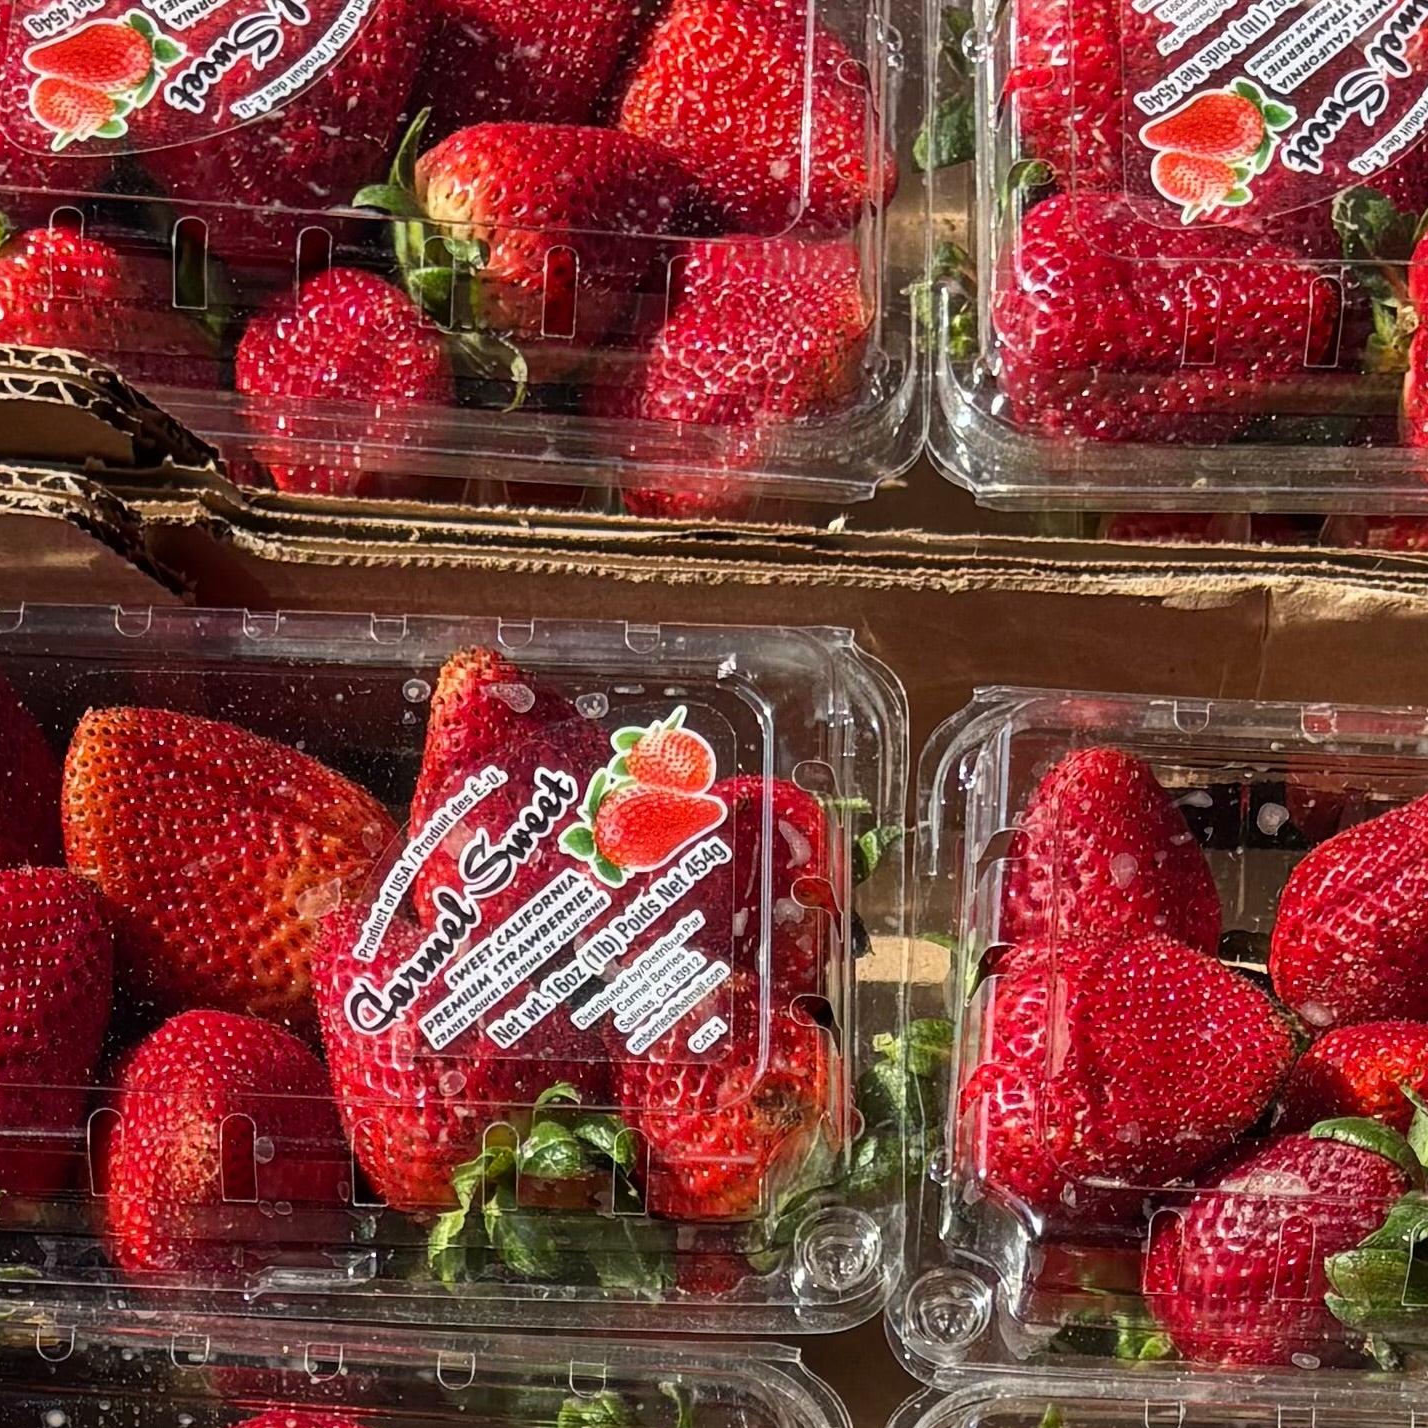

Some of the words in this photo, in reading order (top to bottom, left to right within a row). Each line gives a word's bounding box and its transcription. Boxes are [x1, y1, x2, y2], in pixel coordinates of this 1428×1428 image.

[27, 7, 71, 35] 454g
[169, 16, 280, 110] Sweet
[1197, 33, 1243, 67] Poids
[1138, 82, 1179, 112] 454g
[1172, 61, 1206, 88] Net
[1286, 71, 1385, 171] Sweet
[350, 890, 478, 1032] Carmel
[463, 773, 573, 894] Sweet
[448, 943, 494, 987] SWEET
[495, 872, 580, 946] CALIFORNIA
[423, 972, 494, 1036] PREMIUM
[492, 884, 594, 977] STRAWBERRIES
